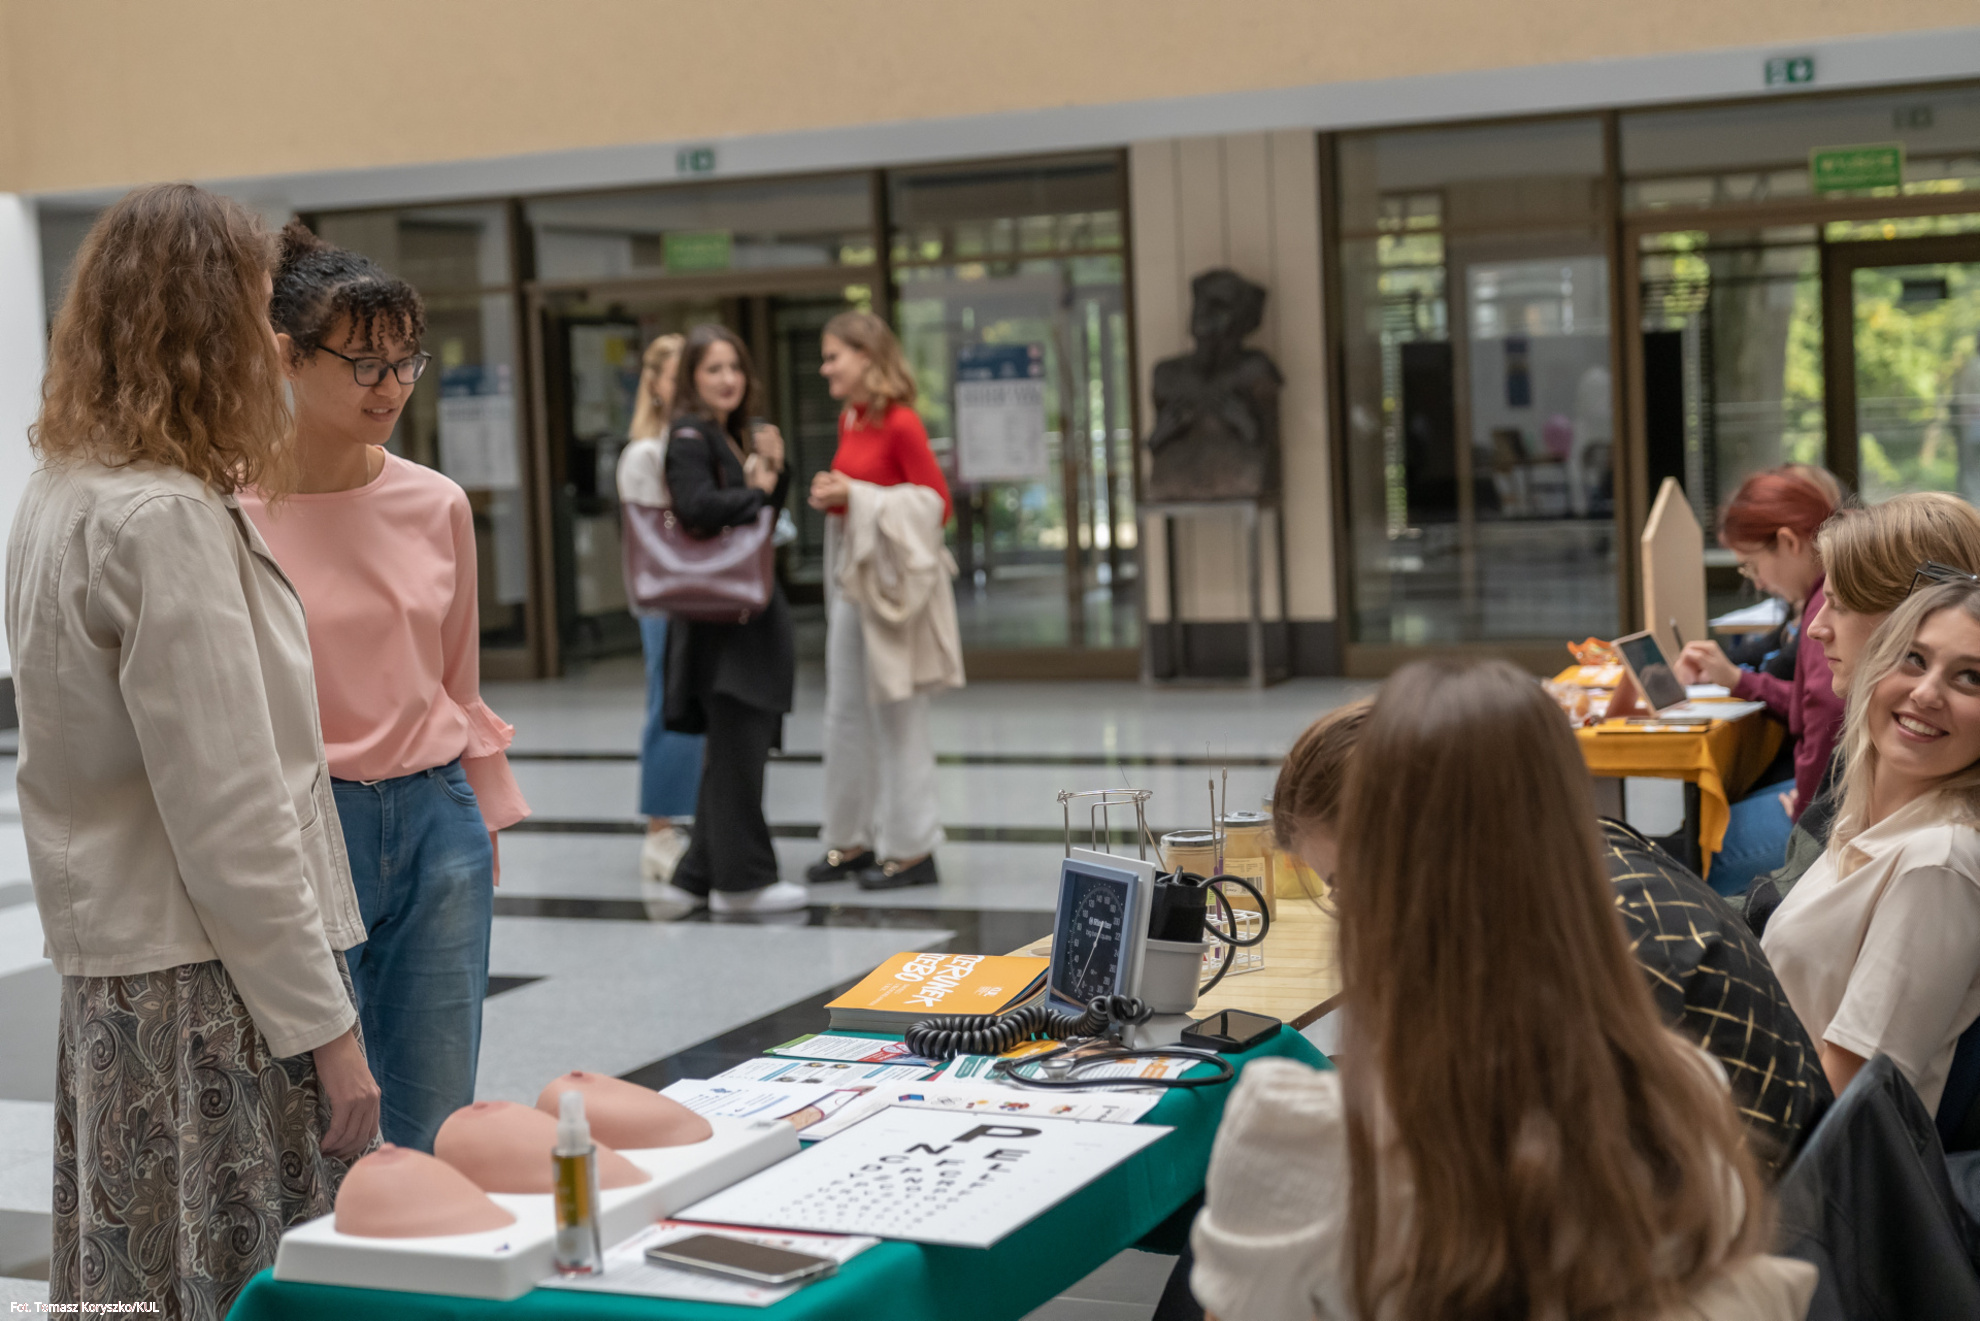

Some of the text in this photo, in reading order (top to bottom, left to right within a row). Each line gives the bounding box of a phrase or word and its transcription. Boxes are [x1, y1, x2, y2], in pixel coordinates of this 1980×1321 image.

[951, 1123, 1042, 1143] P
[904, 1142, 1031, 1162] N E
